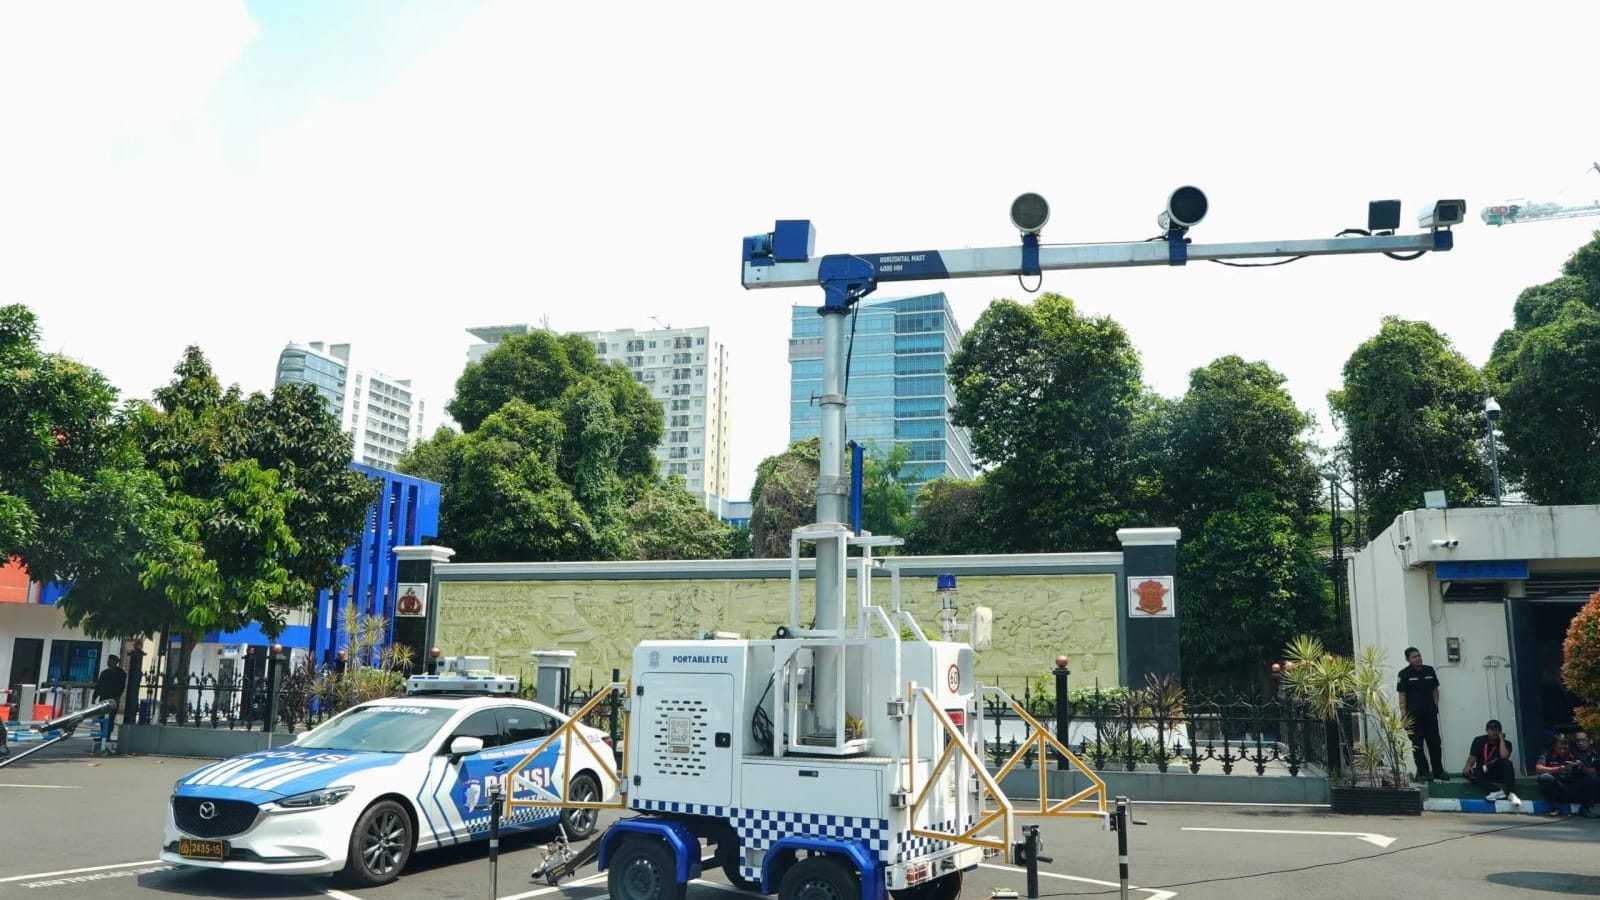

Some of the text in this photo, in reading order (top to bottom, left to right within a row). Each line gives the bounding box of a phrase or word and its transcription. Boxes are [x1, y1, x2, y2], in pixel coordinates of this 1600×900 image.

[879, 264, 893, 272] 4000
[672, 656, 710, 664] PORTABLE
[950, 671, 958, 685] 60
